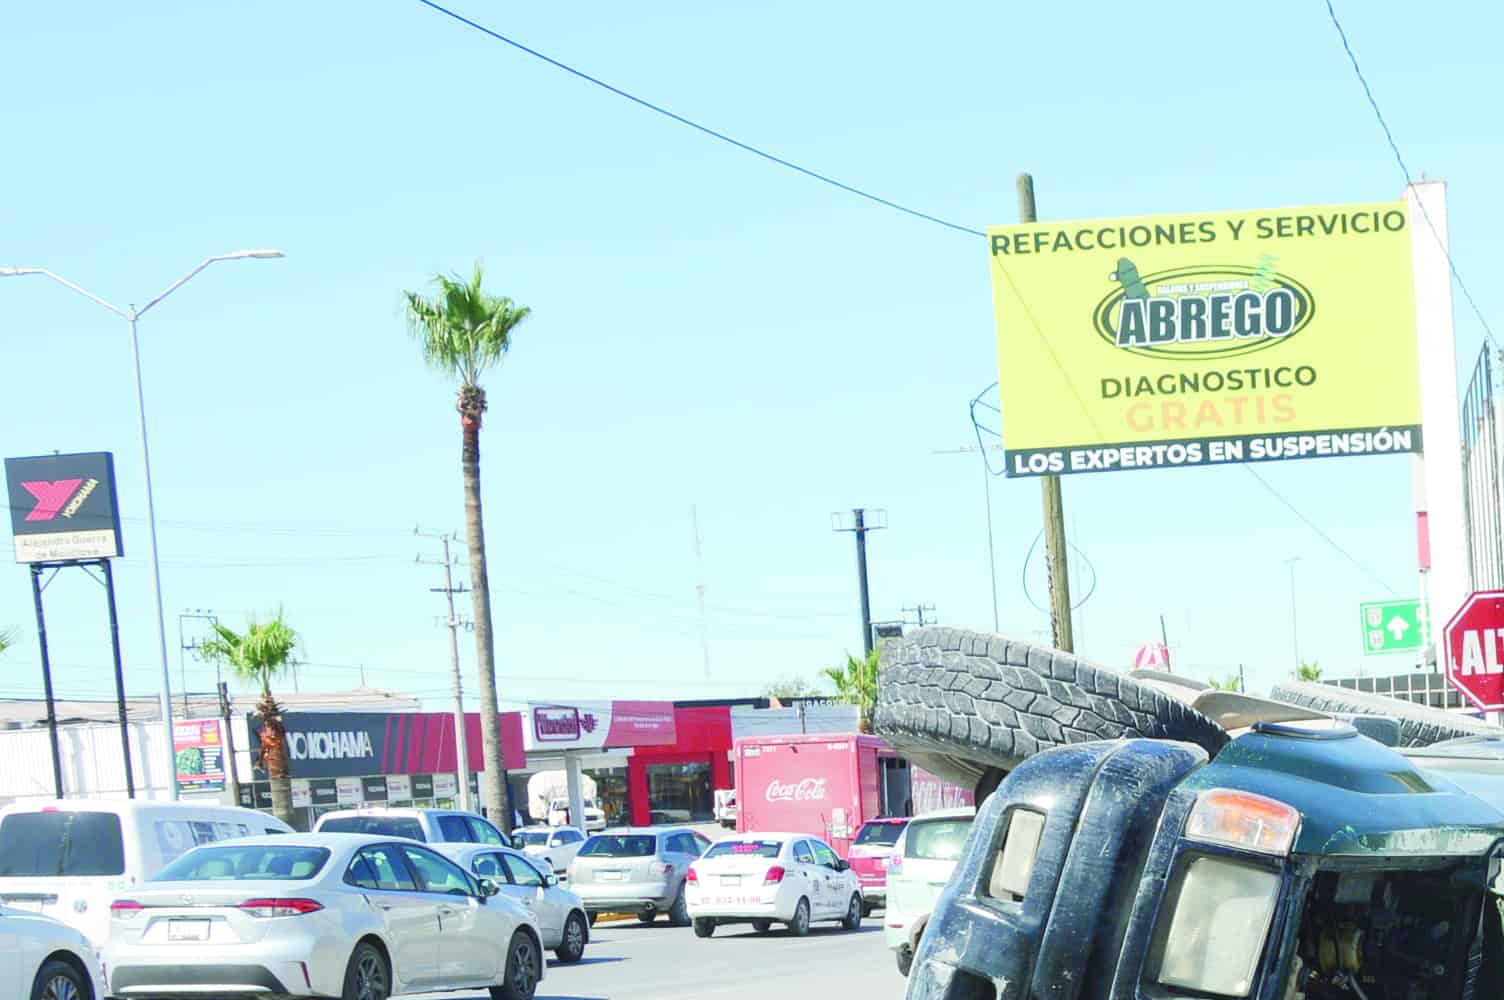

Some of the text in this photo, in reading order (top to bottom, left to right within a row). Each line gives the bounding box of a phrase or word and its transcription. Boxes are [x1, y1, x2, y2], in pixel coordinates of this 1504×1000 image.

[991, 210, 1406, 256] REFACCIONES Y SERVICIO
[1117, 288, 1296, 348] ABREGO
[1100, 365, 1317, 399] DIAGNOSTICO
[1125, 394, 1297, 432] GRATIS
[1014, 427, 1412, 474] LOS EXPERTOS EN SUSPENSIÓN
[286, 731, 374, 760] YOKOHAMA
[765, 778, 828, 802] Coca-Cola
